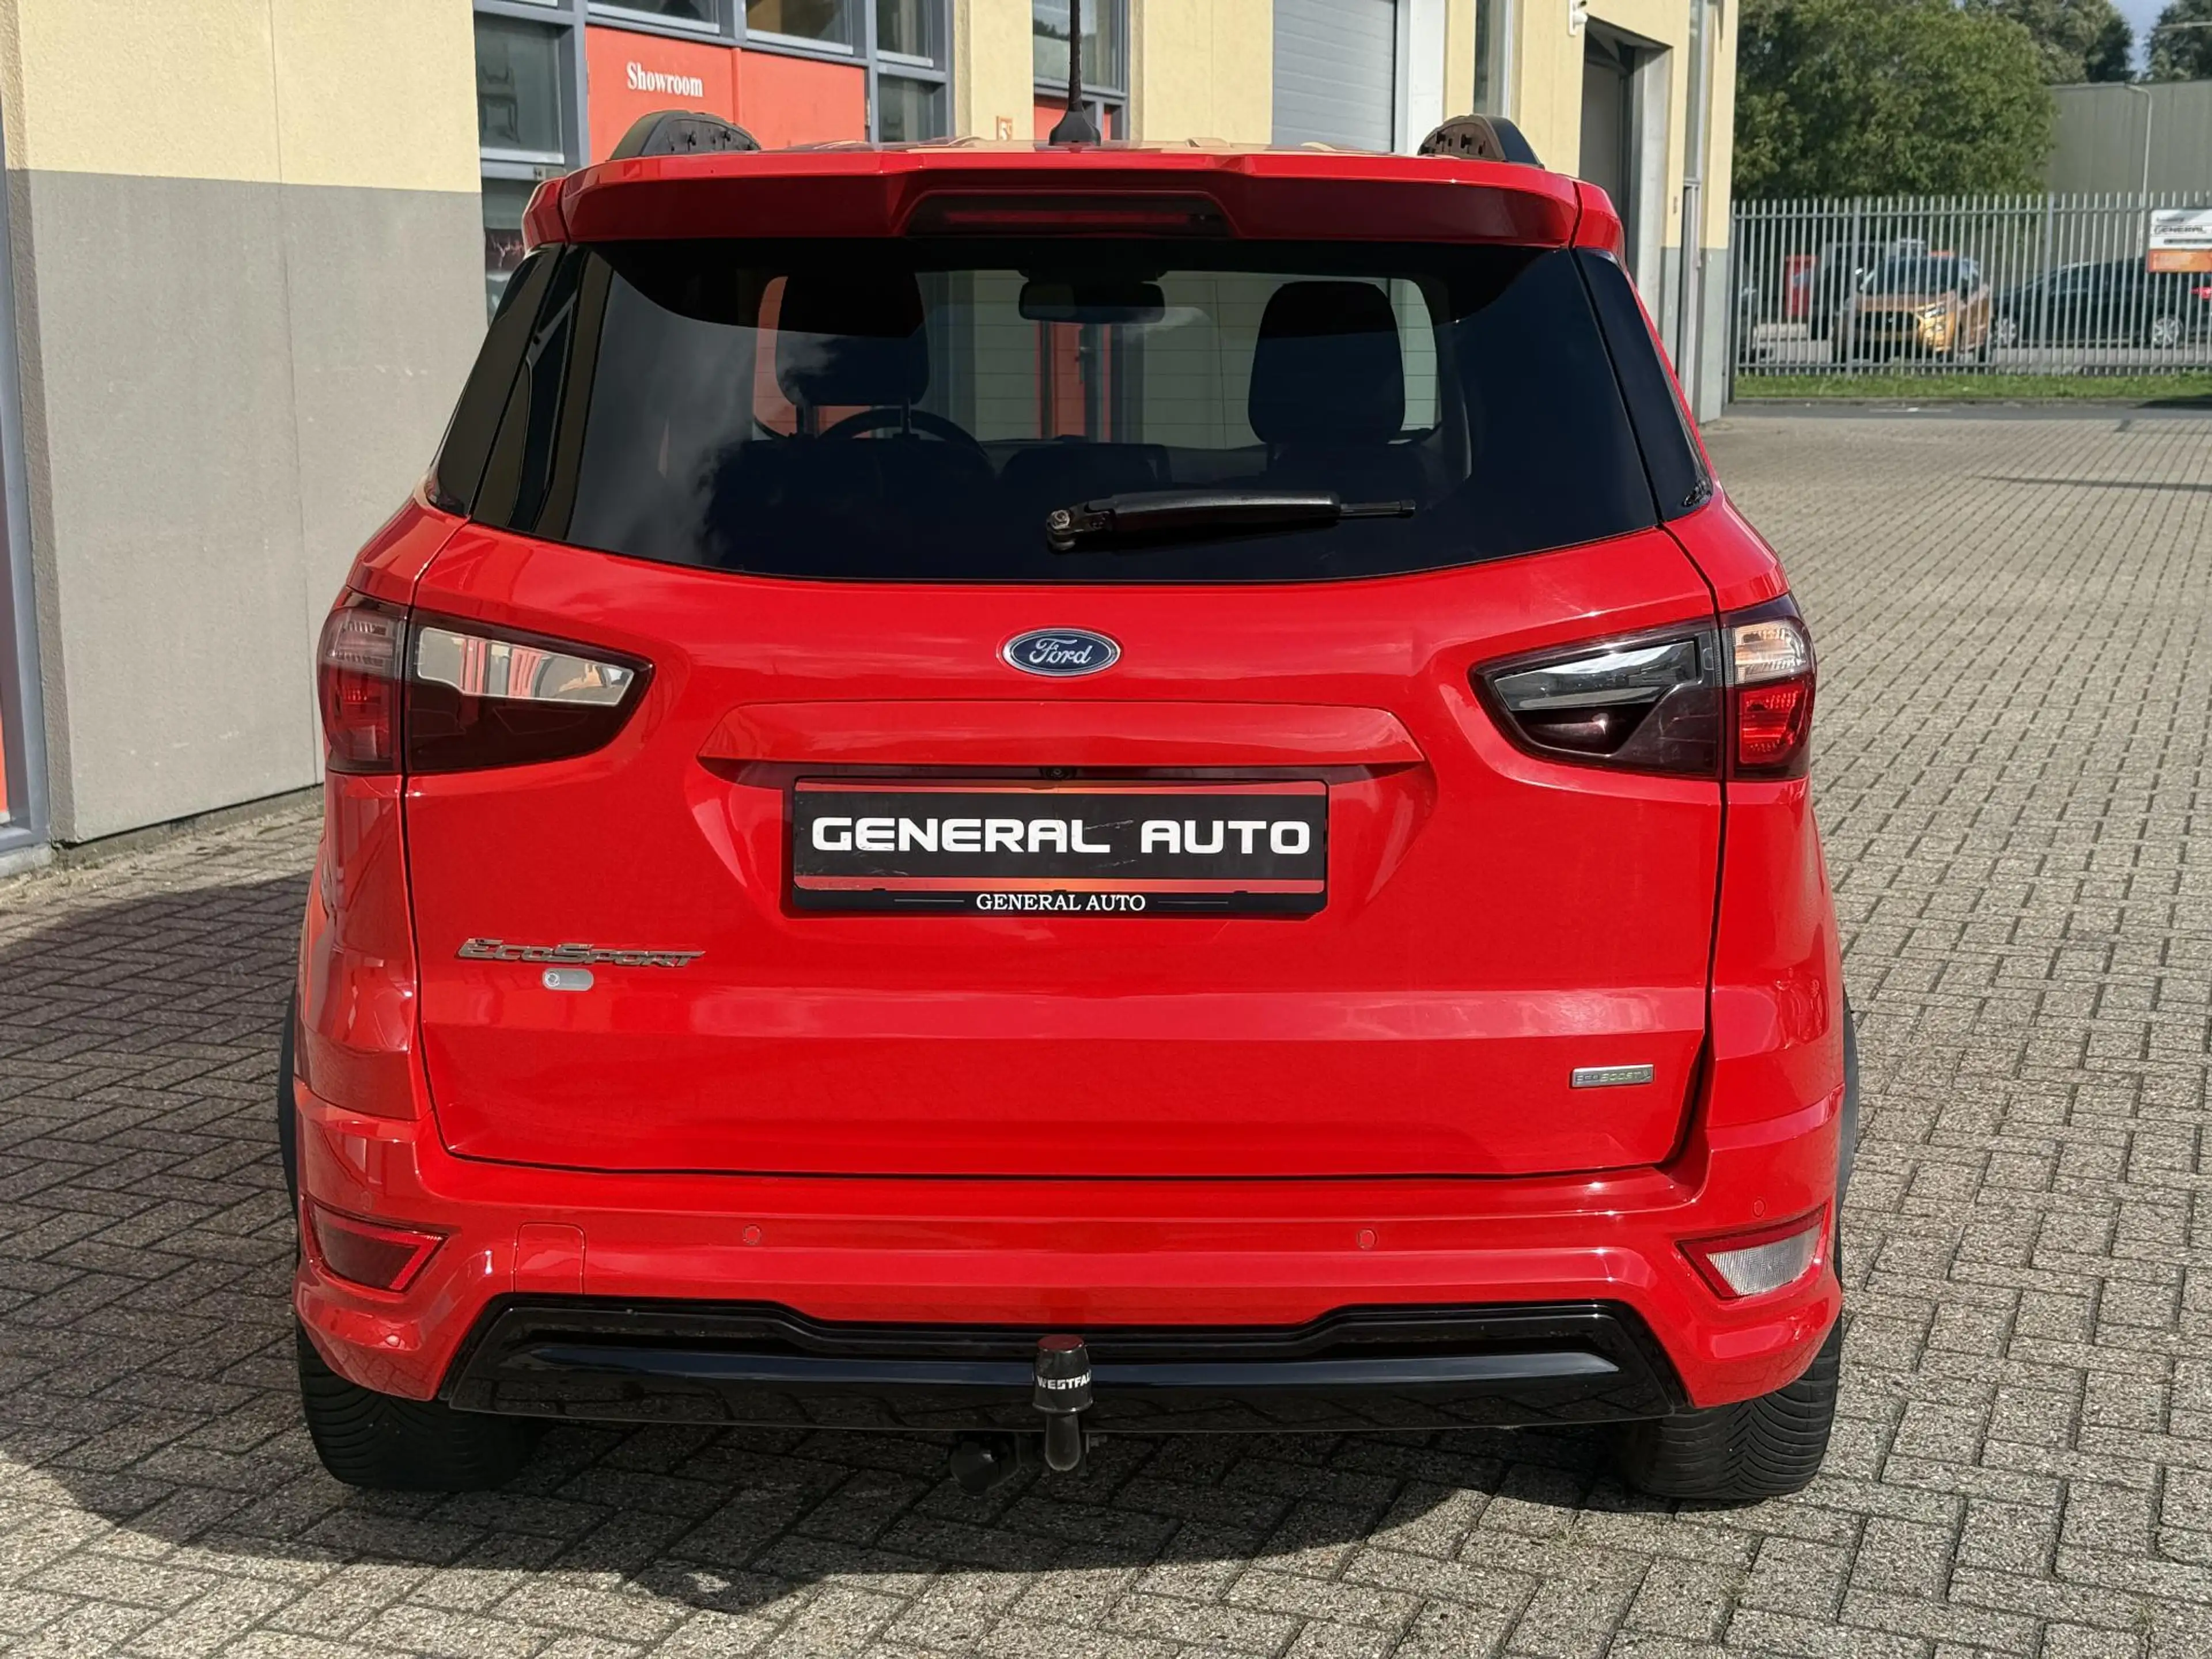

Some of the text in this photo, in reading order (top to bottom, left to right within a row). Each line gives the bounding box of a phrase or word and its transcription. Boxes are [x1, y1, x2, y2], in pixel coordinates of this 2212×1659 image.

[626, 60, 703, 97] Showroom
[2154, 224, 2207, 235] GENERAL
[1029, 638, 1093, 664] Ford
[812, 817, 1310, 855] GENERAL AUTO
[976, 893, 1146, 911] GENERAL AUTO
